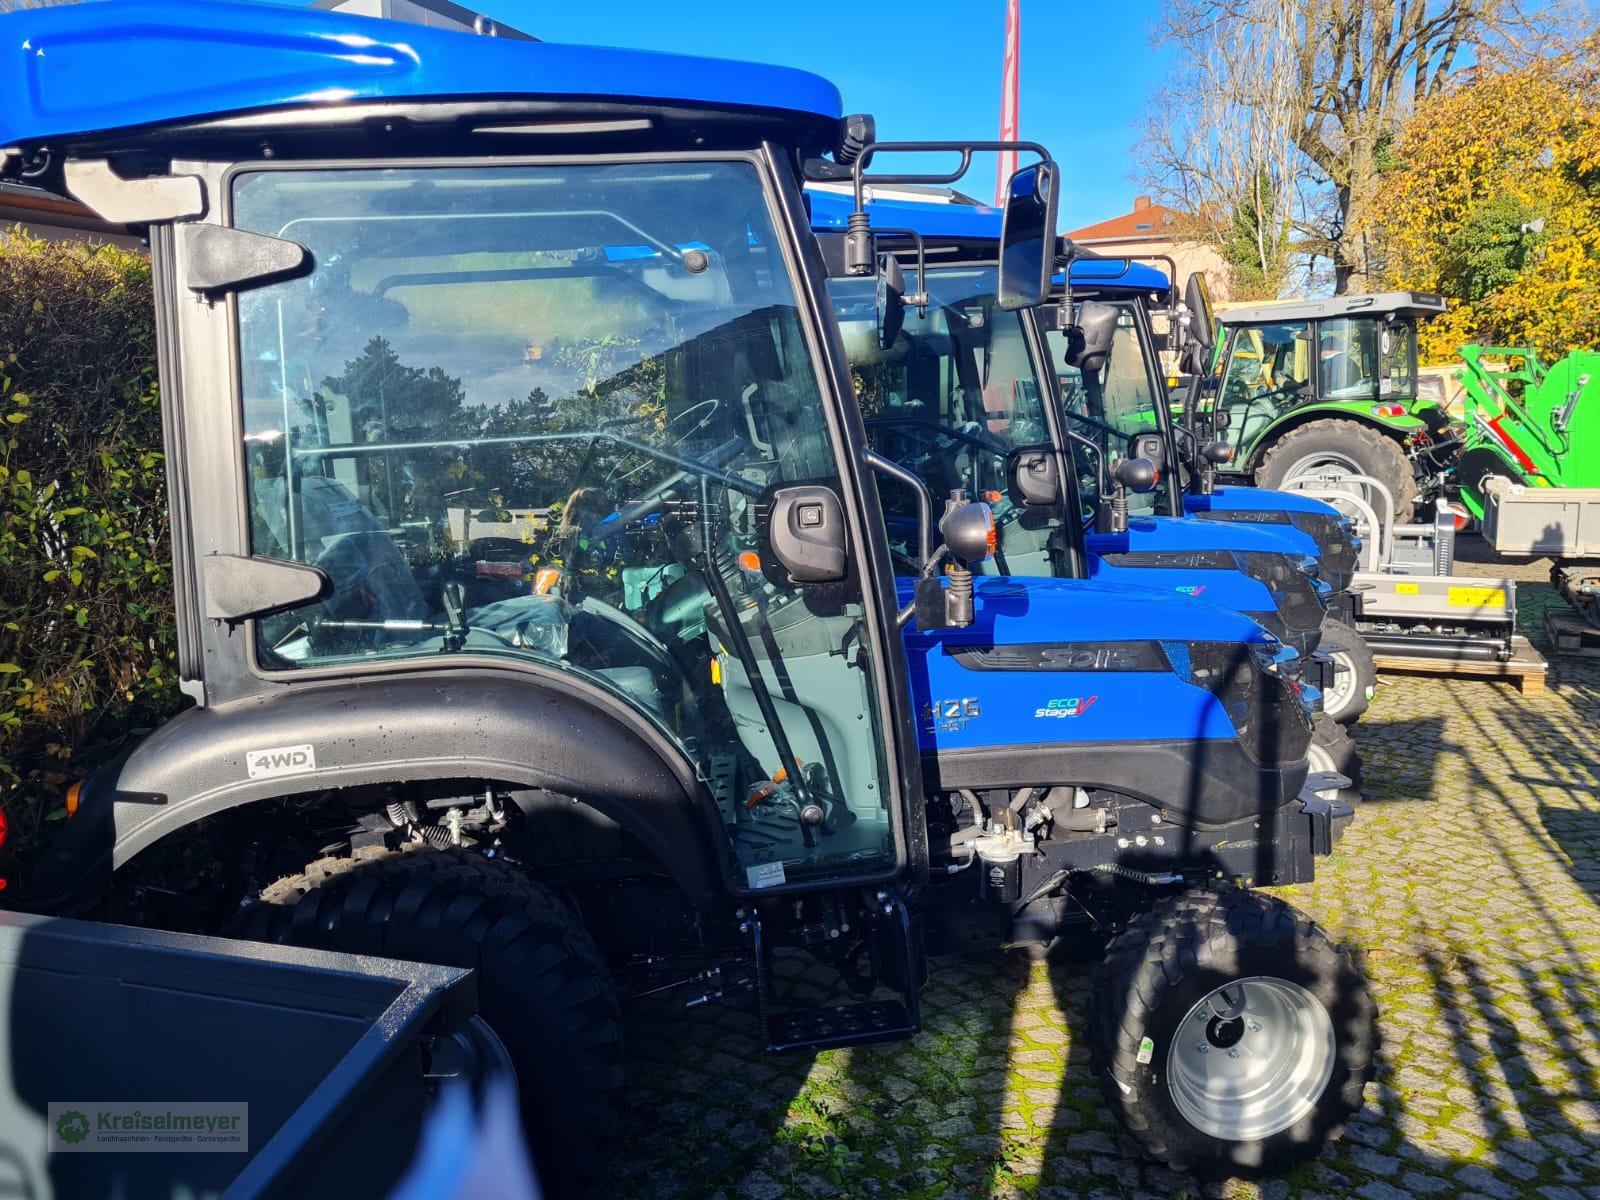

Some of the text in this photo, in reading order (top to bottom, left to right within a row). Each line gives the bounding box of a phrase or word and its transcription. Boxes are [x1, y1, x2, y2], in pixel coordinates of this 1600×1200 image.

[1048, 698, 1079, 708] ECO
[1035, 708, 1079, 719] stage
[254, 751, 308, 770] 4WD
